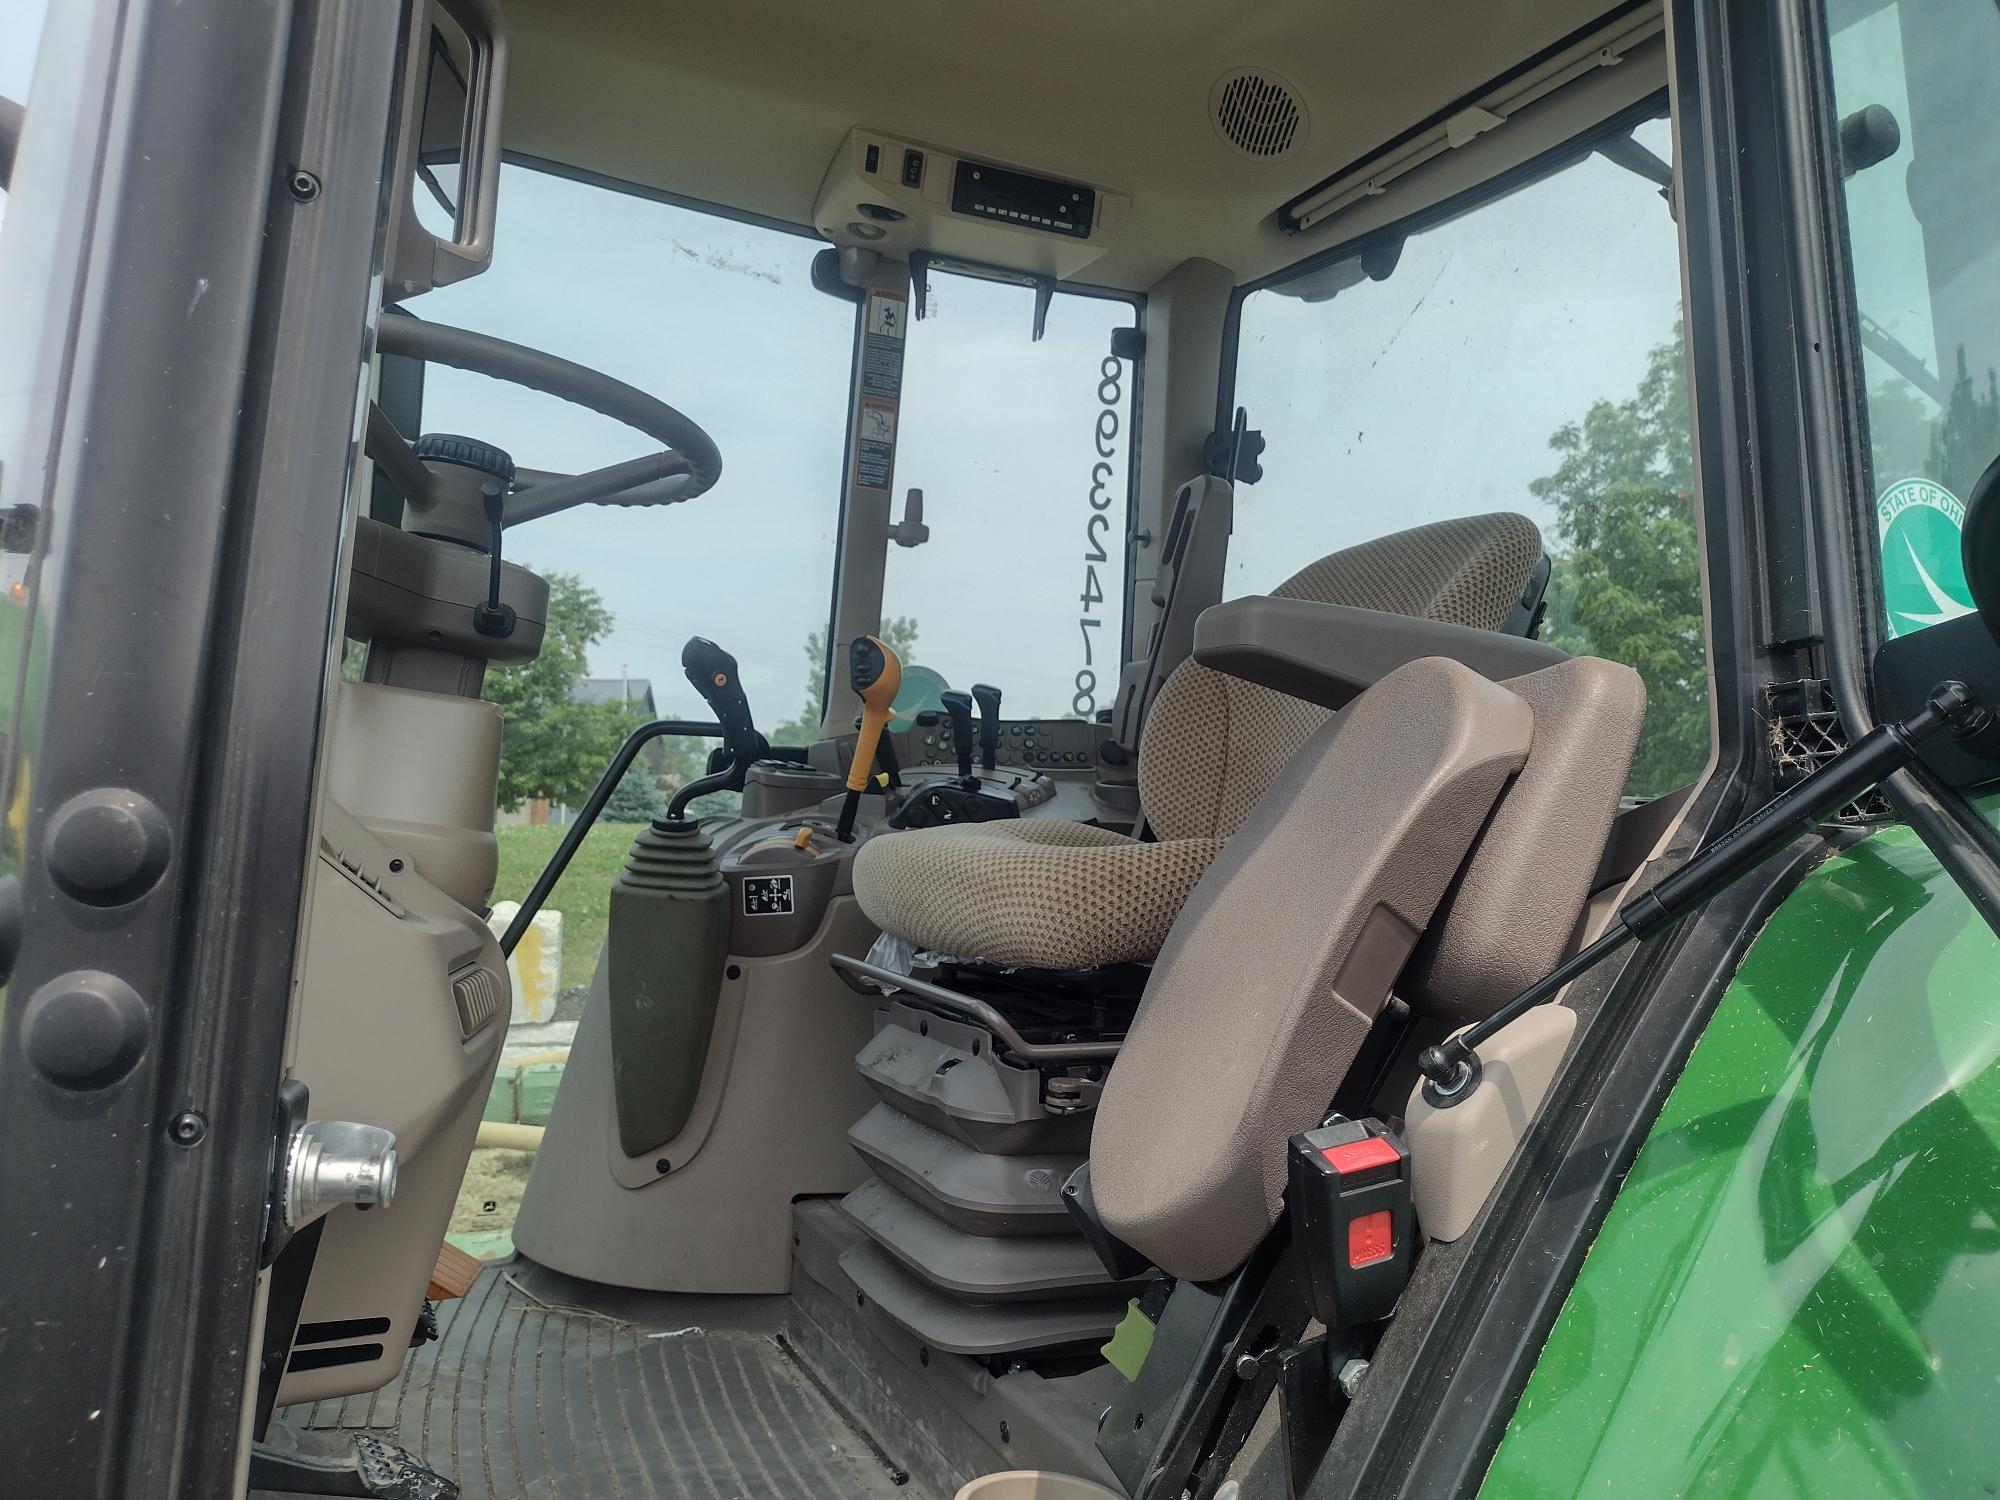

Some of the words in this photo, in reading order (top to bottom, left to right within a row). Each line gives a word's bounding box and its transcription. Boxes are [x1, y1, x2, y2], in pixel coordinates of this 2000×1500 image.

[1882, 487, 1916, 521] STATE
[1920, 487, 1937, 504] OF
[1940, 497, 1963, 526] OHI
[1354, 1243, 1386, 1261] PRESS
